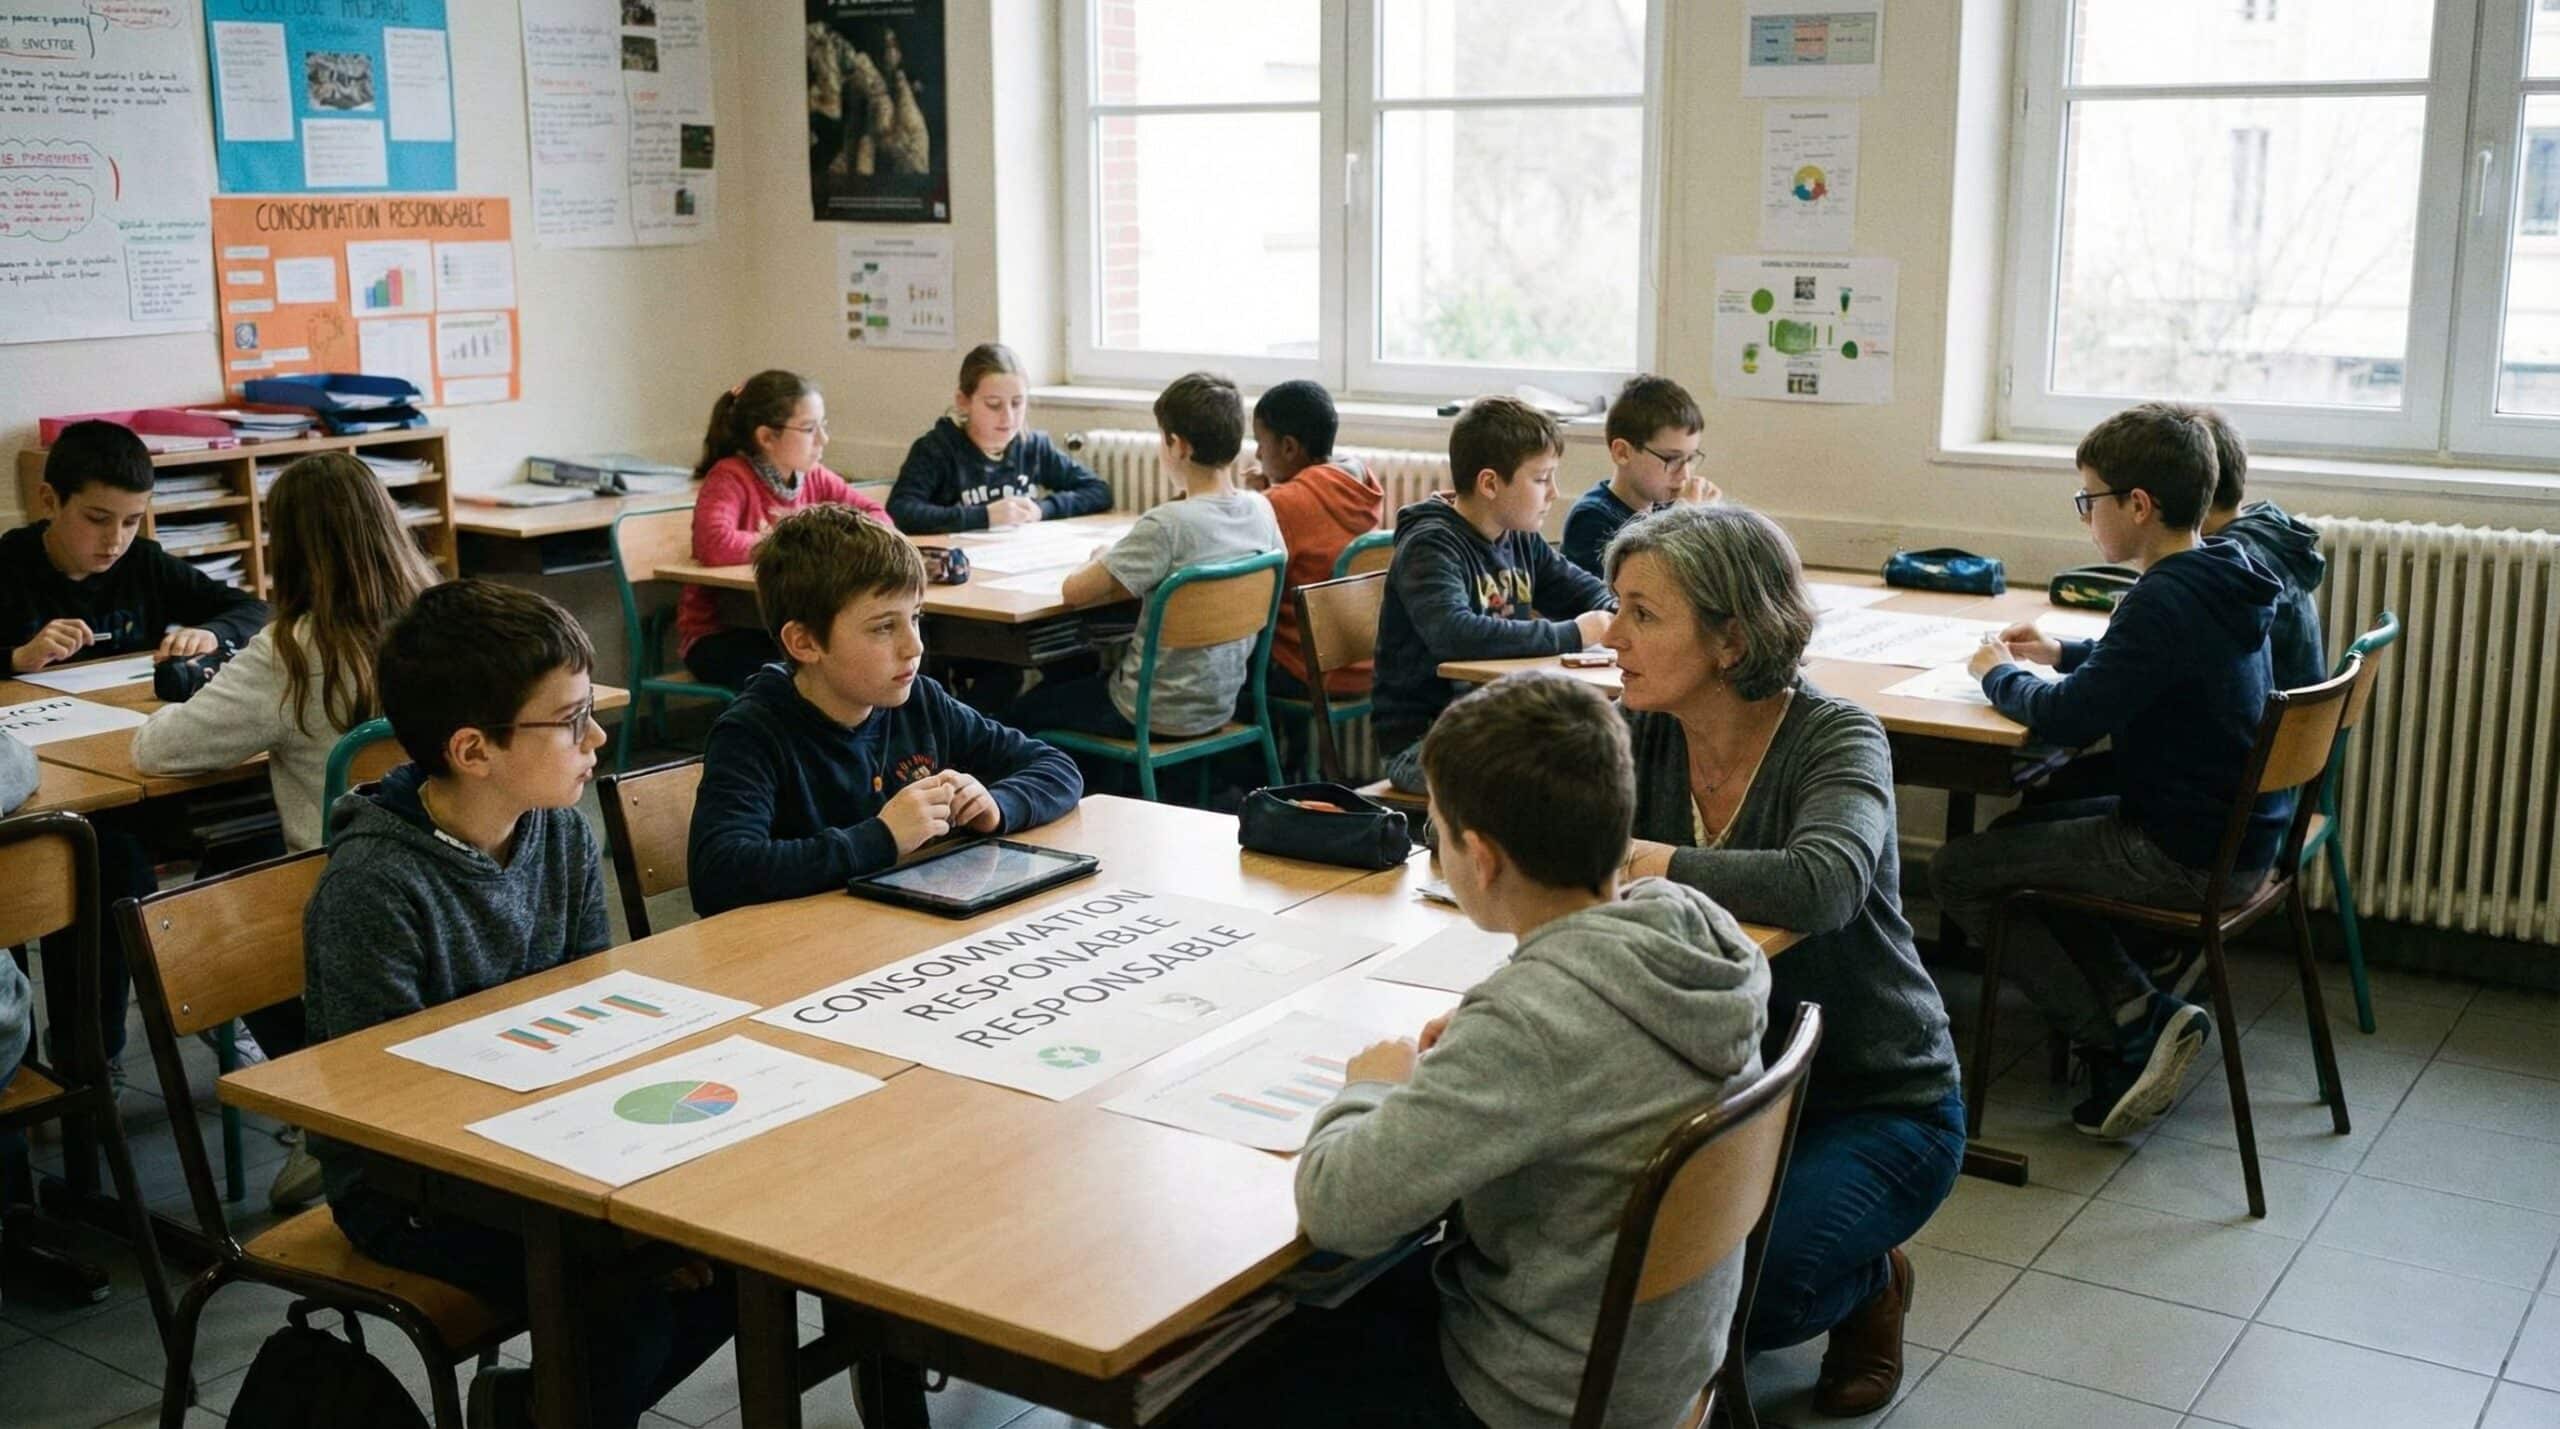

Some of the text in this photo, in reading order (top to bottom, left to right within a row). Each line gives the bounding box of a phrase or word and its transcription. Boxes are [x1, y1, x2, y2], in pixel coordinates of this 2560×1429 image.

[256, 201, 486, 231] CONSOMMATION RESPONSABLE
[793, 889, 1154, 1024] CONSOMMATION
[903, 913, 1180, 1022] RESPONABLE
[955, 925, 1255, 1049] RESPONSABLE
